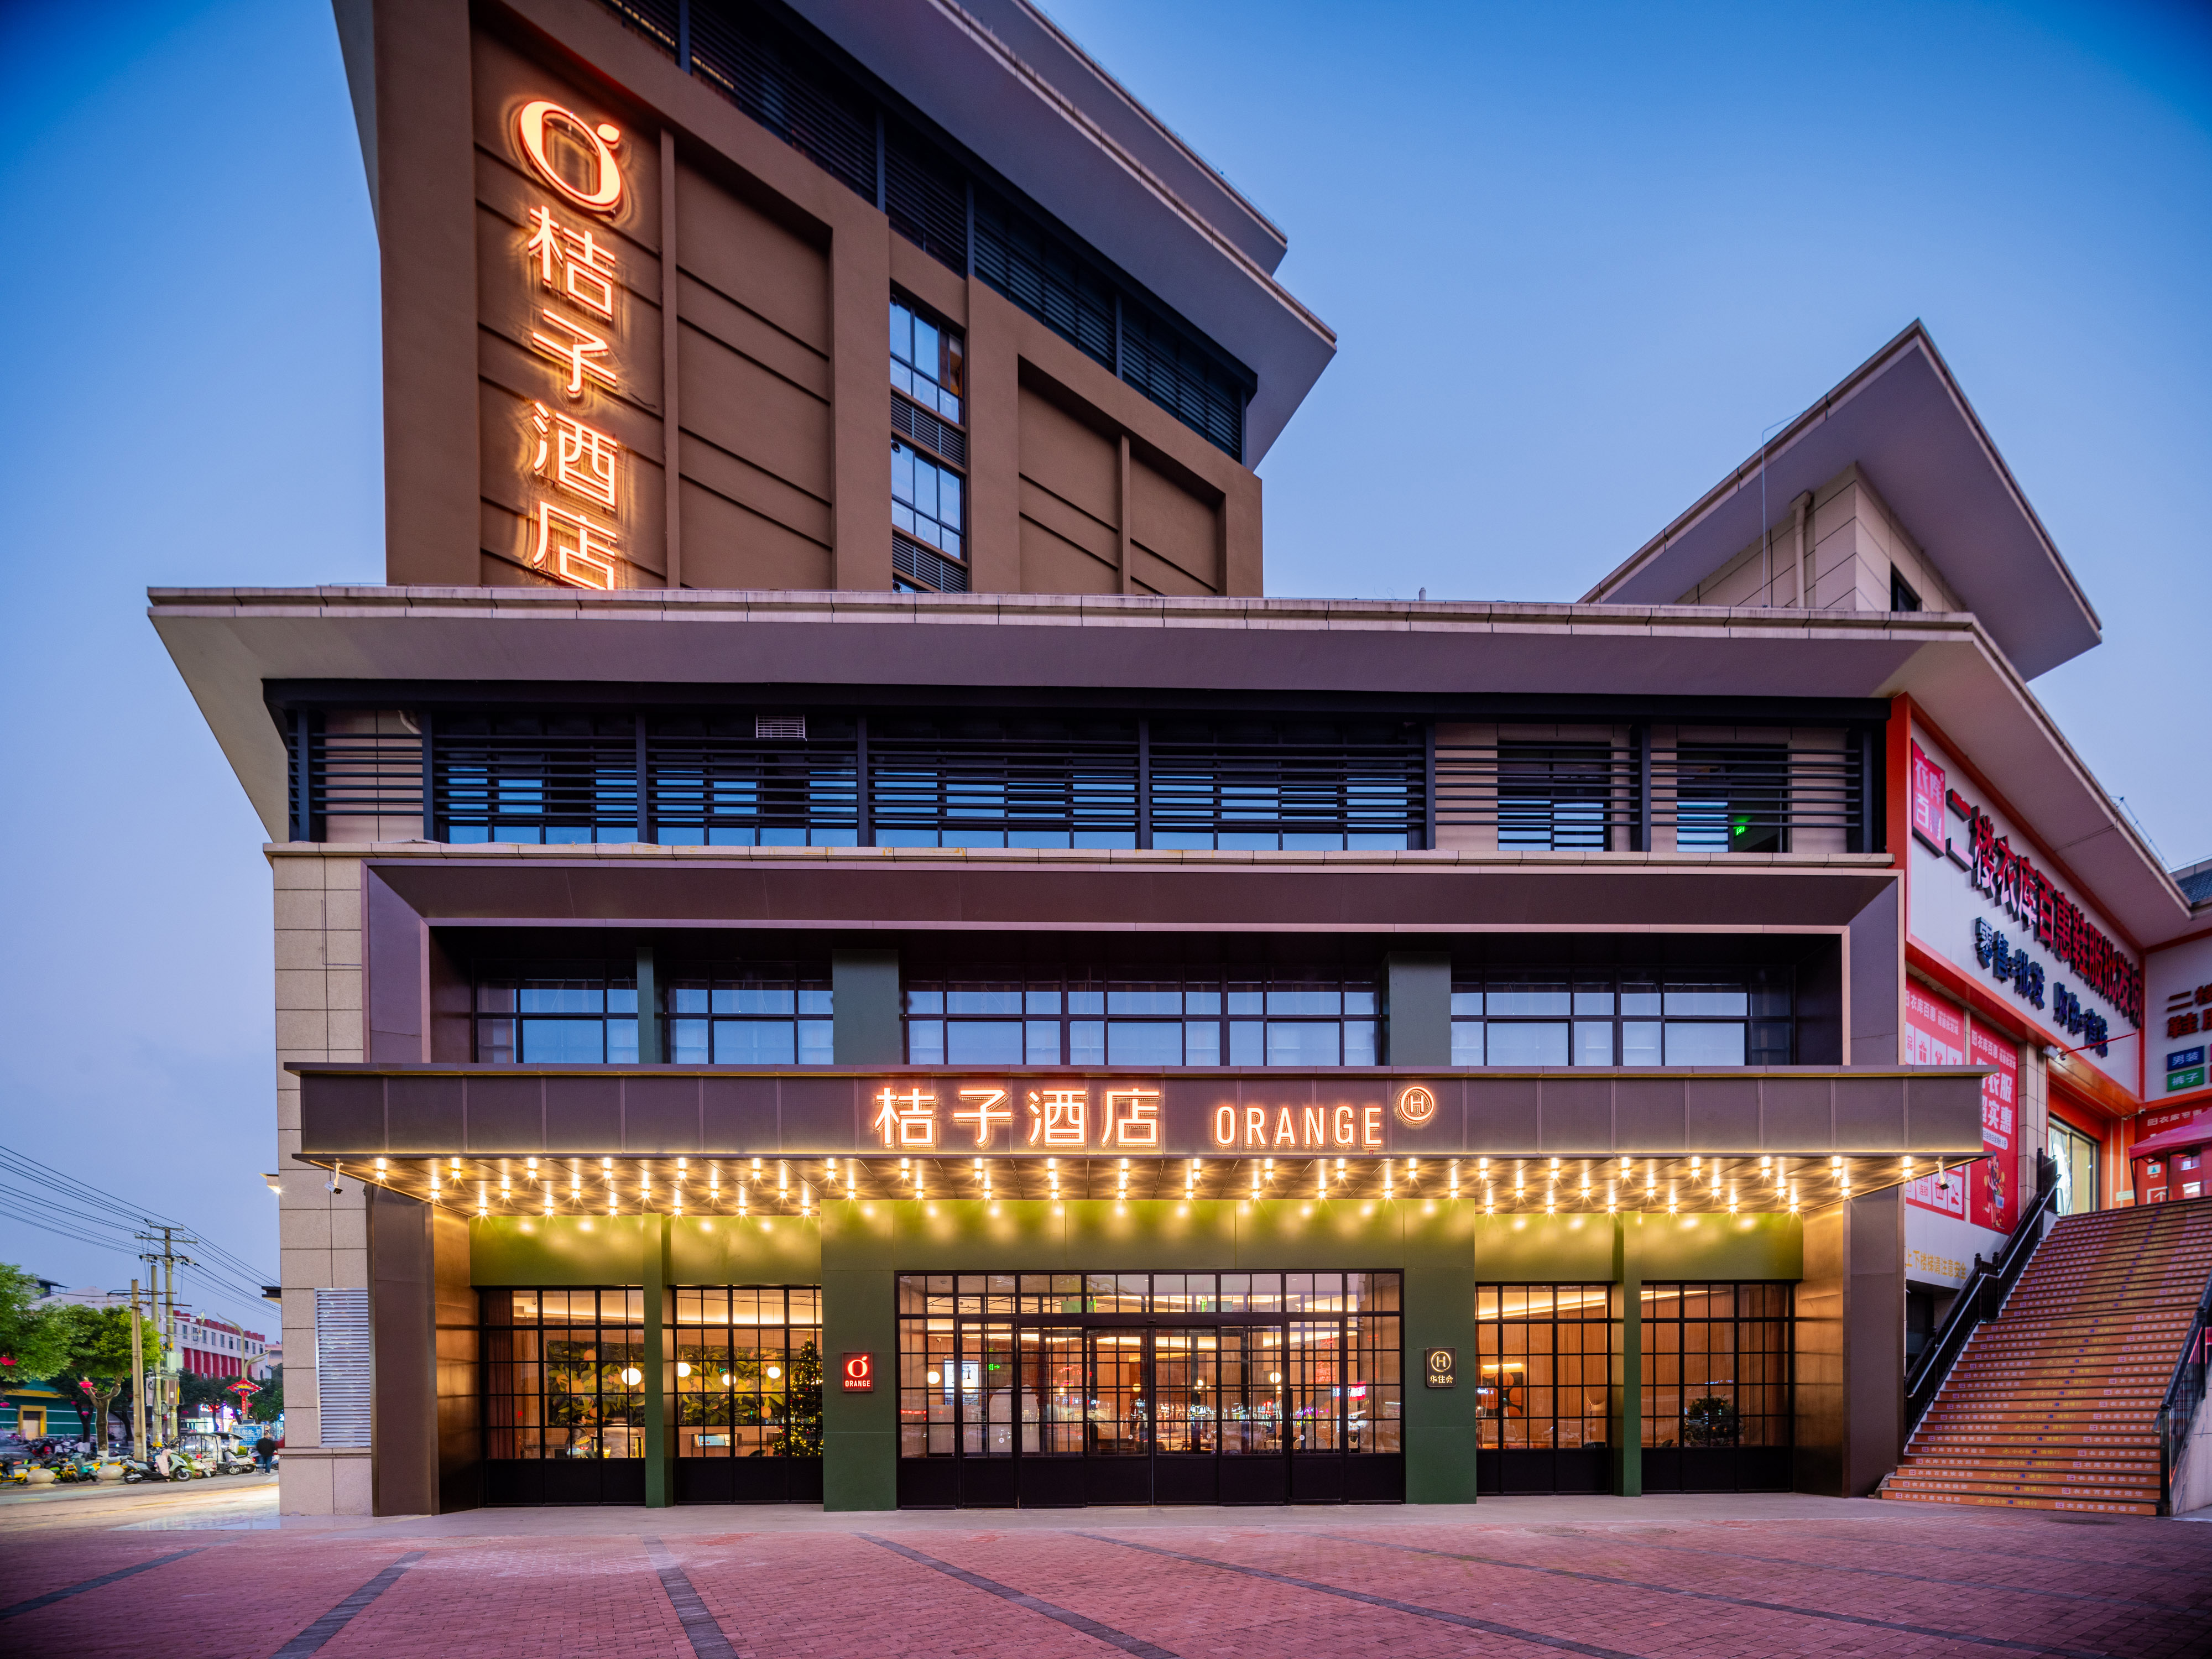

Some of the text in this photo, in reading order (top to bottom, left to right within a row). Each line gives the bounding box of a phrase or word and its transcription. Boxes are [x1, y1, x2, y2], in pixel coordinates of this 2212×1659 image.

[527, 205, 618, 590] 桔子酒店
[2172, 1051, 2199, 1067] 男装
[2172, 1072, 2199, 1087] 裤子
[875, 1087, 1160, 1147] 桔子酒店
[1214, 1105, 1381, 1148] ORANGE
[1906, 1249, 1966, 1280] 上下楼梯请注意安全
[1430, 1375, 1453, 1384] 华住会
